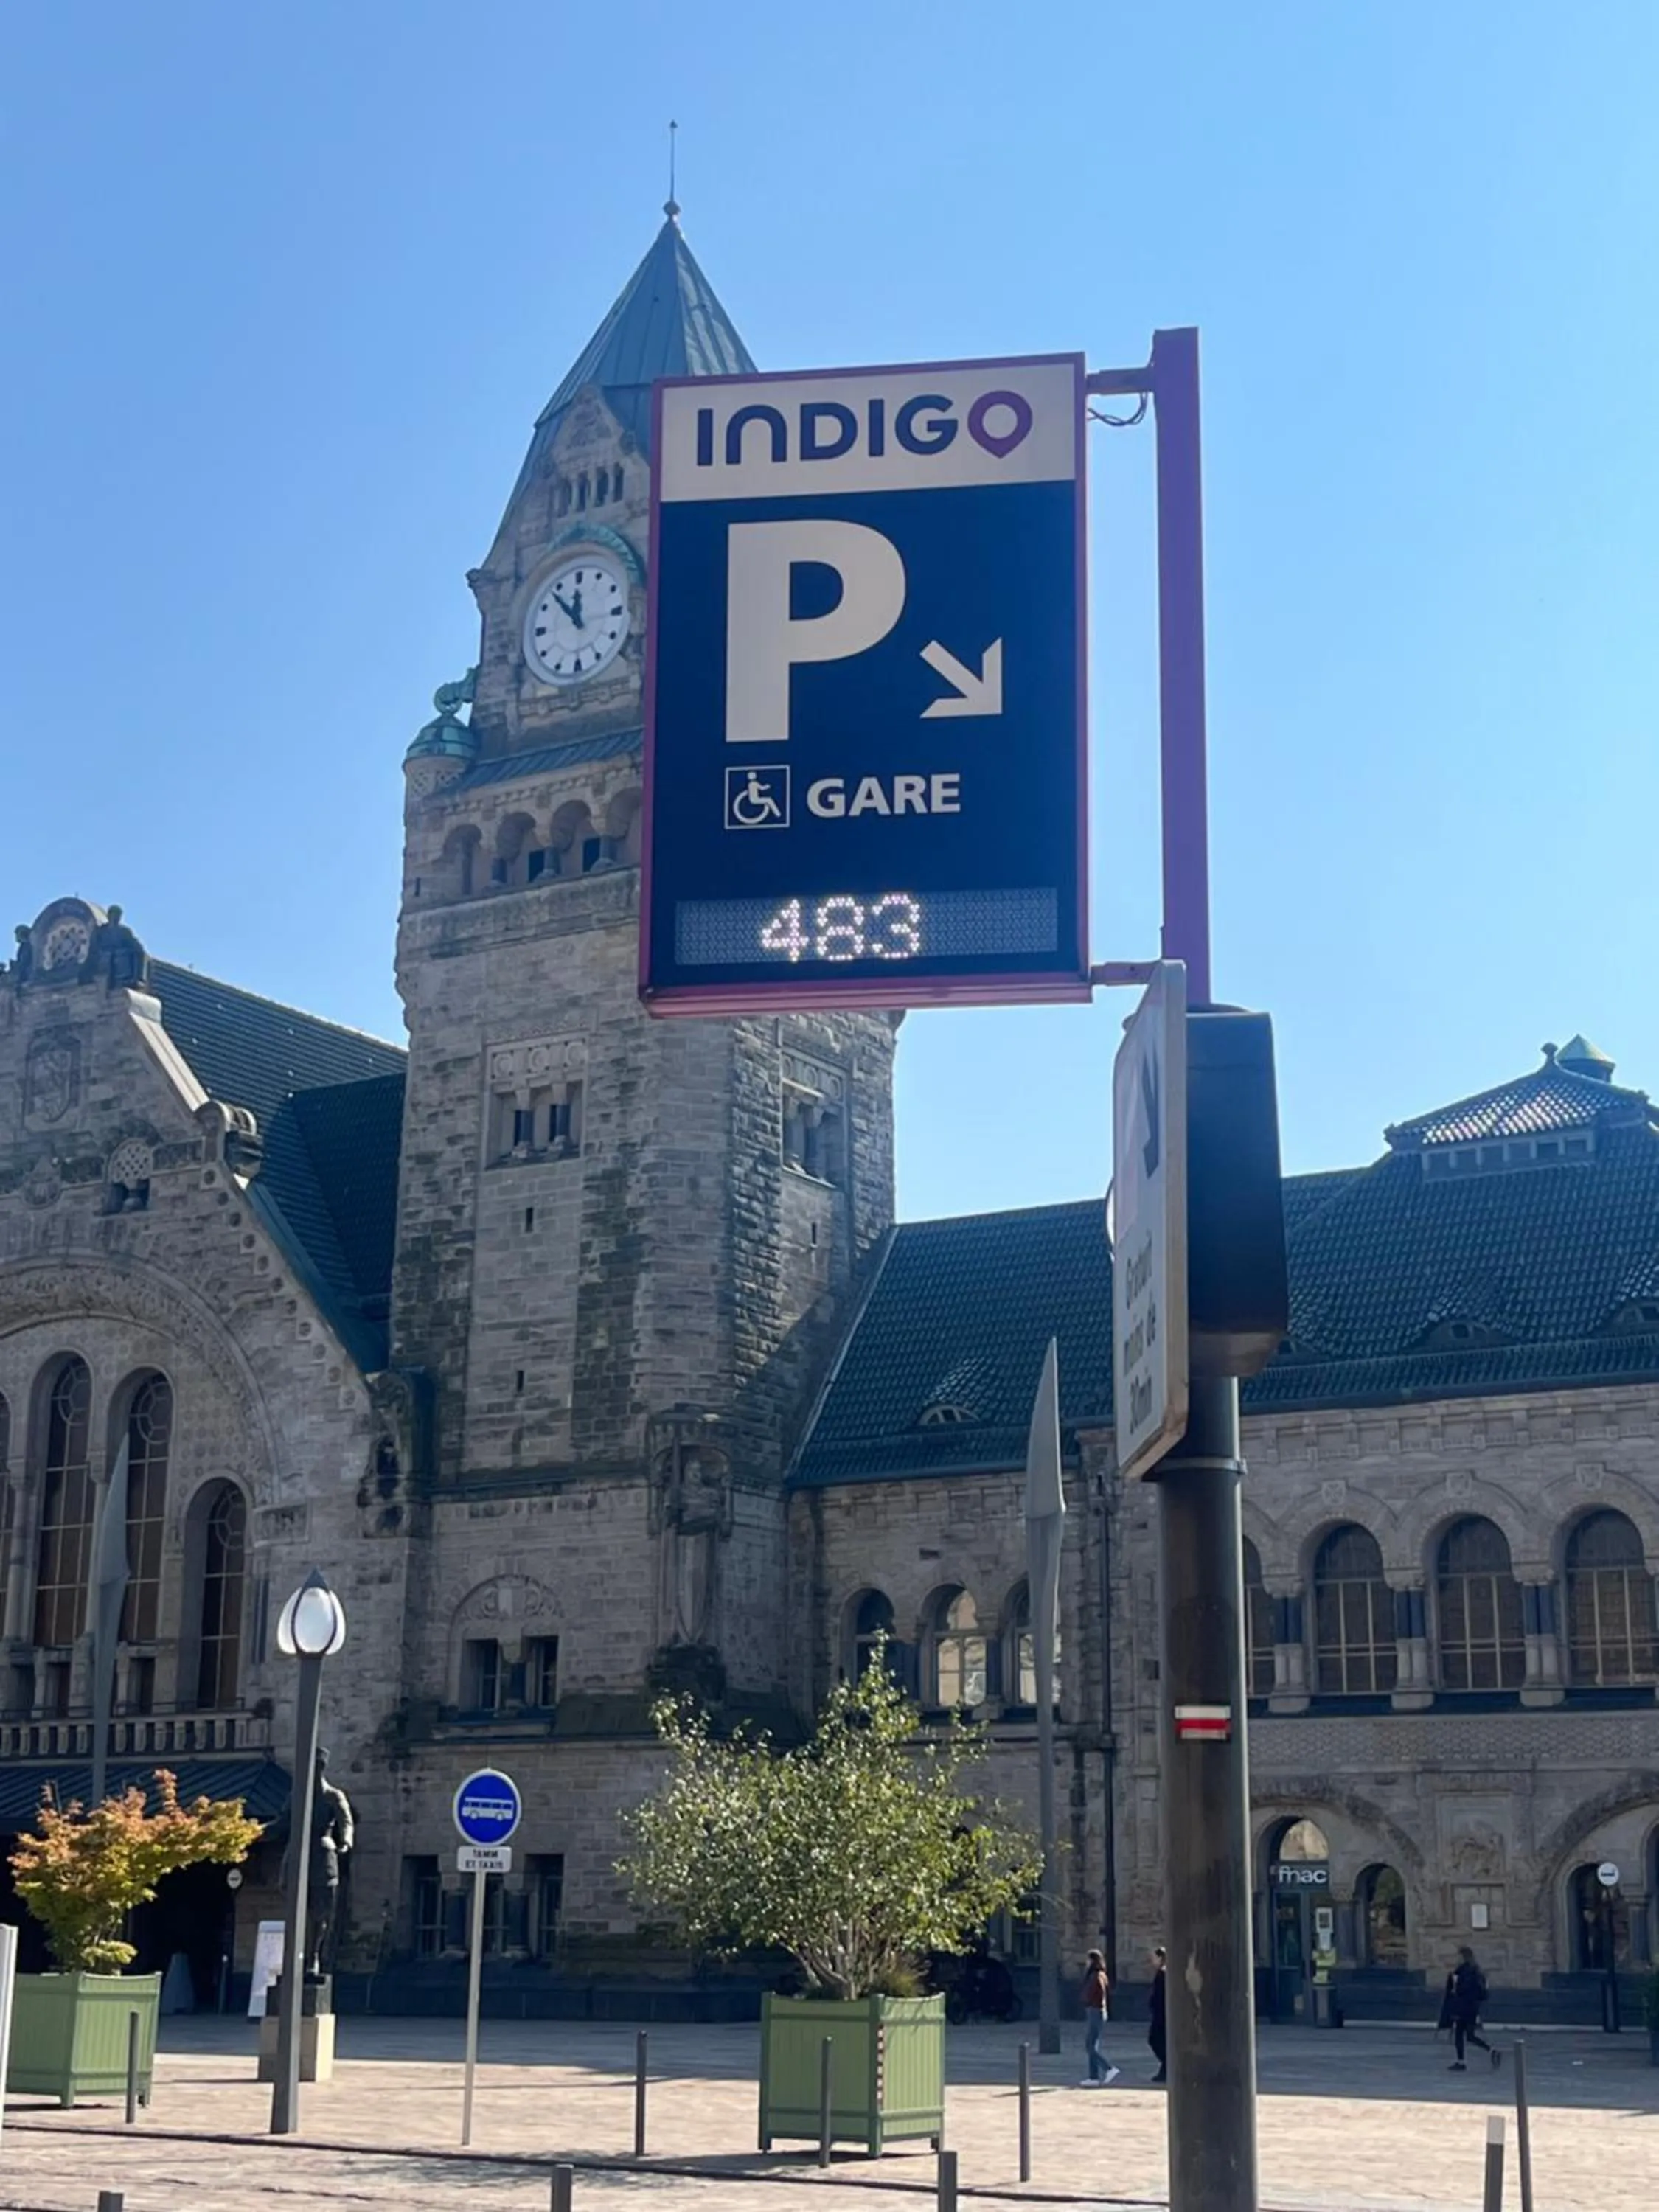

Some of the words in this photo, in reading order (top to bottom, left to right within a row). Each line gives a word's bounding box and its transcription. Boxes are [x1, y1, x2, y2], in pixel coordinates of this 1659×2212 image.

[695, 390, 1032, 467] INDIGO
[725, 519, 905, 743] P
[806, 773, 961, 818] GARE
[761, 892, 921, 962] 483
[1279, 1865, 1327, 1883] fnac
